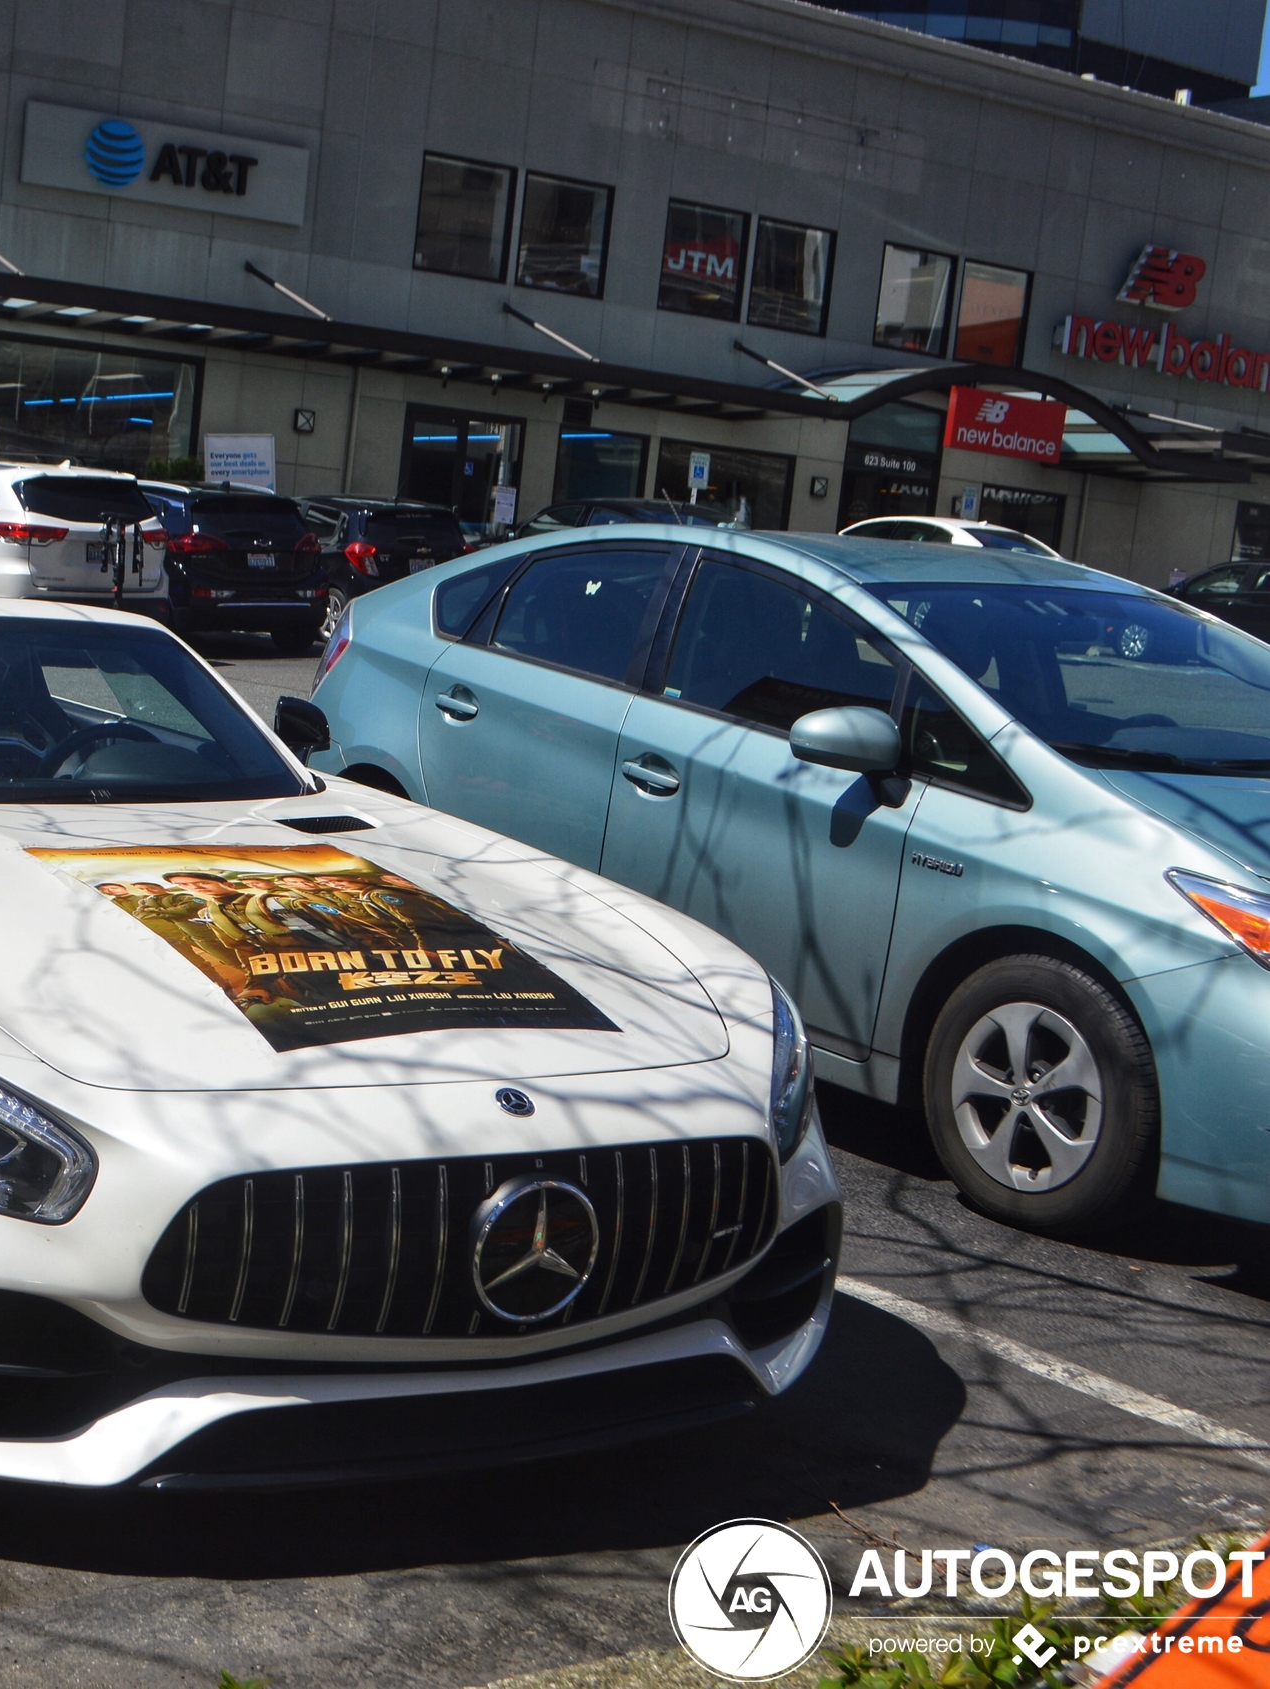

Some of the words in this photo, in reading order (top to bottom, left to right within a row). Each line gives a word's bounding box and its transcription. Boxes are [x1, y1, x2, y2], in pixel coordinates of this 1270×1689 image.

[150, 143, 259, 196] AT&T
[668, 248, 734, 280] JTM
[1061, 315, 1156, 369] new
[957, 426, 991, 445] new
[991, 428, 1056, 456] balance
[210, 452, 241, 460] Everyone
[242, 452, 257, 460] gets
[864, 454, 879, 467] 823
[880, 457, 901, 469] Suite
[902, 460, 917, 472] 100
[210, 469, 230, 477] every
[231, 469, 270, 477] smartphone
[912, 852, 956, 875] HYBRID
[249, 950, 368, 976] BORN
[371, 949, 432, 969] TO
[438, 948, 504, 970] FLY
[338, 971, 483, 991] 长空之王
[328, 1000, 349, 1009] GUI
[349, 996, 383, 1006] GUAN
[386, 993, 407, 1003] LIU
[408, 992, 452, 1001] XIAOSHI
[513, 992, 556, 1000] XIAOSHI
